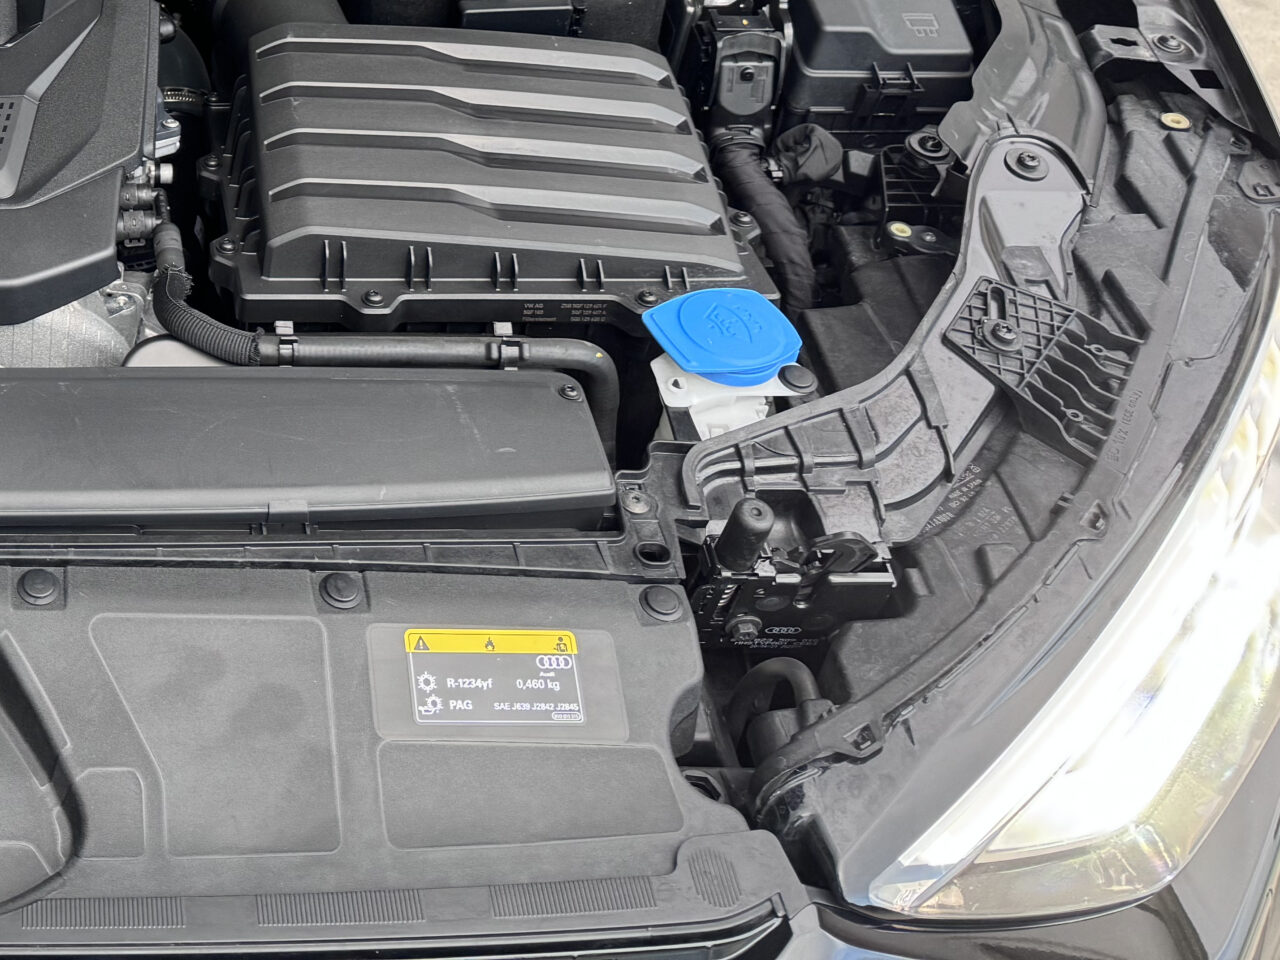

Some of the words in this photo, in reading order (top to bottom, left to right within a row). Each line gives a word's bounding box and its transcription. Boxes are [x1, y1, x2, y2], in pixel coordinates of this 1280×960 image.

[446, 678, 493, 690] R-1234yf
[516, 679, 545, 690] 0,460
[547, 679, 561, 692] kg
[449, 699, 473, 710] PAG
[493, 702, 511, 711] SAE
[511, 702, 531, 711] J639
[531, 703, 555, 711] J2842
[556, 703, 580, 711] J2845
